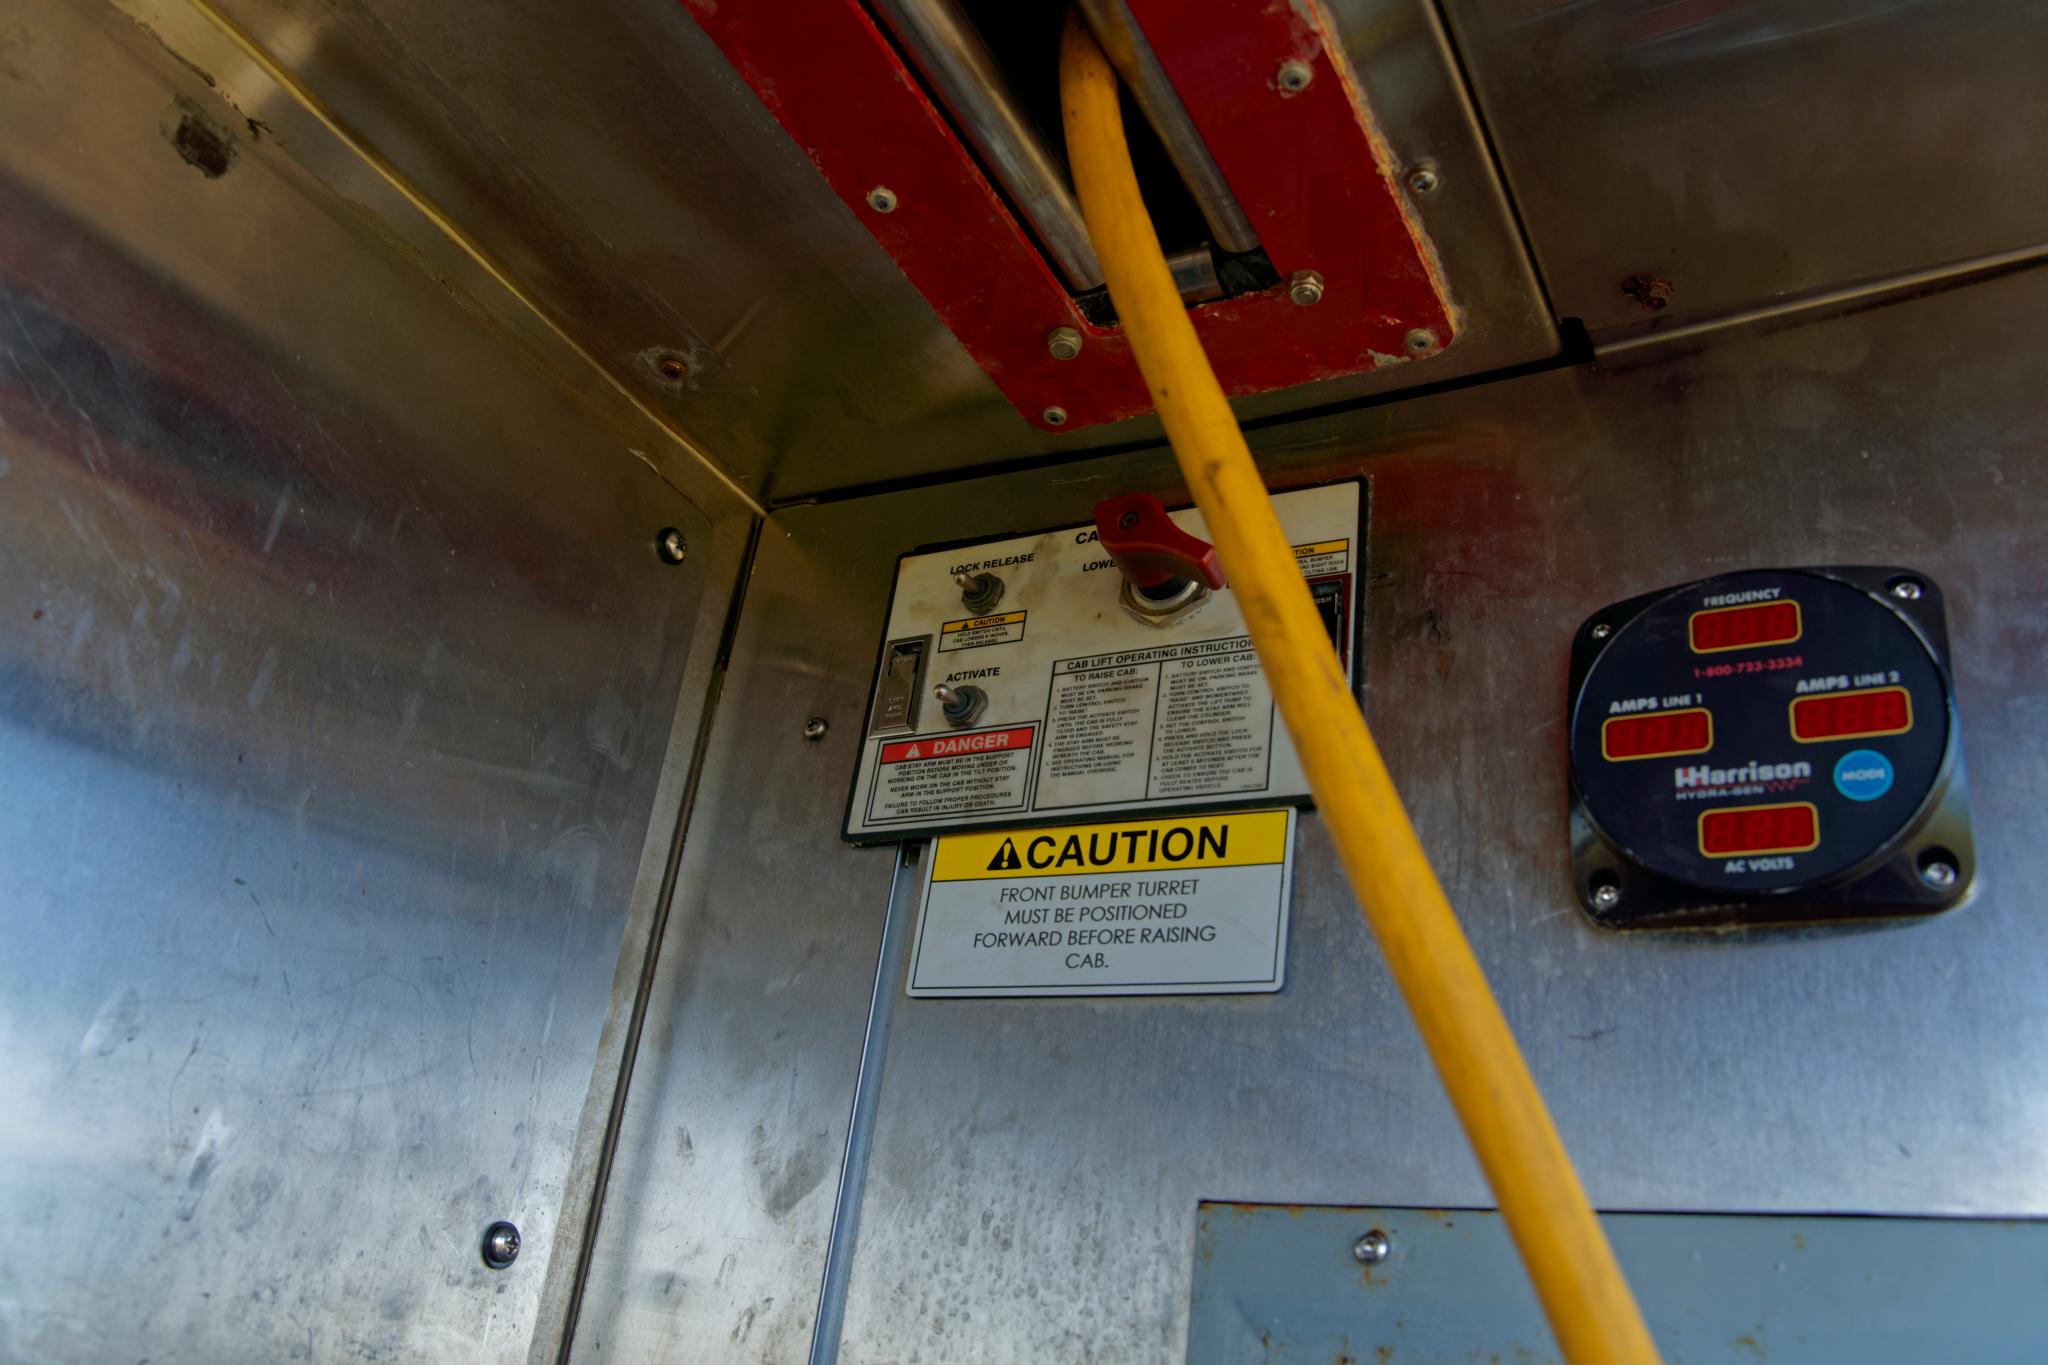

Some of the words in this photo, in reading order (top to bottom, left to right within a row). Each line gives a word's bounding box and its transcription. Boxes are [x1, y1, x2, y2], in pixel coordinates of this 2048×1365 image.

[1076, 530, 1098, 544] CA
[950, 562, 980, 574] LOCK
[983, 553, 1035, 569] RELEASE
[1083, 560, 1117, 572] LOWE
[1704, 588, 1781, 607] FREQUENCY
[973, 616, 1006, 626] CAUTION
[964, 634, 983, 642] LOWERS
[972, 628, 991, 636] SWITCH
[1067, 661, 1088, 670] CAB
[1091, 657, 1112, 668] LIFT
[1116, 649, 1178, 664] OPERATING
[1180, 640, 1255, 656] INSTRUCTION
[1181, 660, 1194, 668] TO
[1196, 656, 1229, 666] LOWER
[946, 667, 1000, 682] ACTIVATE
[1088, 670, 1114, 680] RAISE
[1116, 668, 1138, 676] CAB:
[1796, 675, 1849, 694] AMPS
[1854, 673, 1886, 686] LINE
[1890, 670, 1900, 683] 2
[1609, 698, 1658, 714] AMPS
[1662, 695, 1691, 708] LINE
[1696, 694, 1702, 704] 1
[933, 733, 1009, 754] DANGER
[985, 752, 1013, 760] SUPPORT
[1674, 761, 1811, 788] Harrison
[1841, 768, 1885, 781] MODE
[970, 791, 1011, 800] PROCEDURES
[1676, 786, 1764, 800] HYDRA-GEN
[1028, 825, 1228, 870] CAUTION
[1725, 860, 1745, 874] AC
[1750, 857, 1794, 872] VOLTS
[1001, 886, 1055, 903] FRONT
[1060, 882, 1130, 900] BUMPER
[1137, 879, 1200, 897] TURRET
[1004, 908, 1050, 926] MUST
[1054, 906, 1074, 923] BE
[1079, 903, 1186, 922] POSITIONED
[974, 931, 1062, 948] FORWARD
[1068, 928, 1135, 946] BEFORE
[1140, 926, 1216, 944] RAISING
[1066, 952, 1109, 969] CAB.
